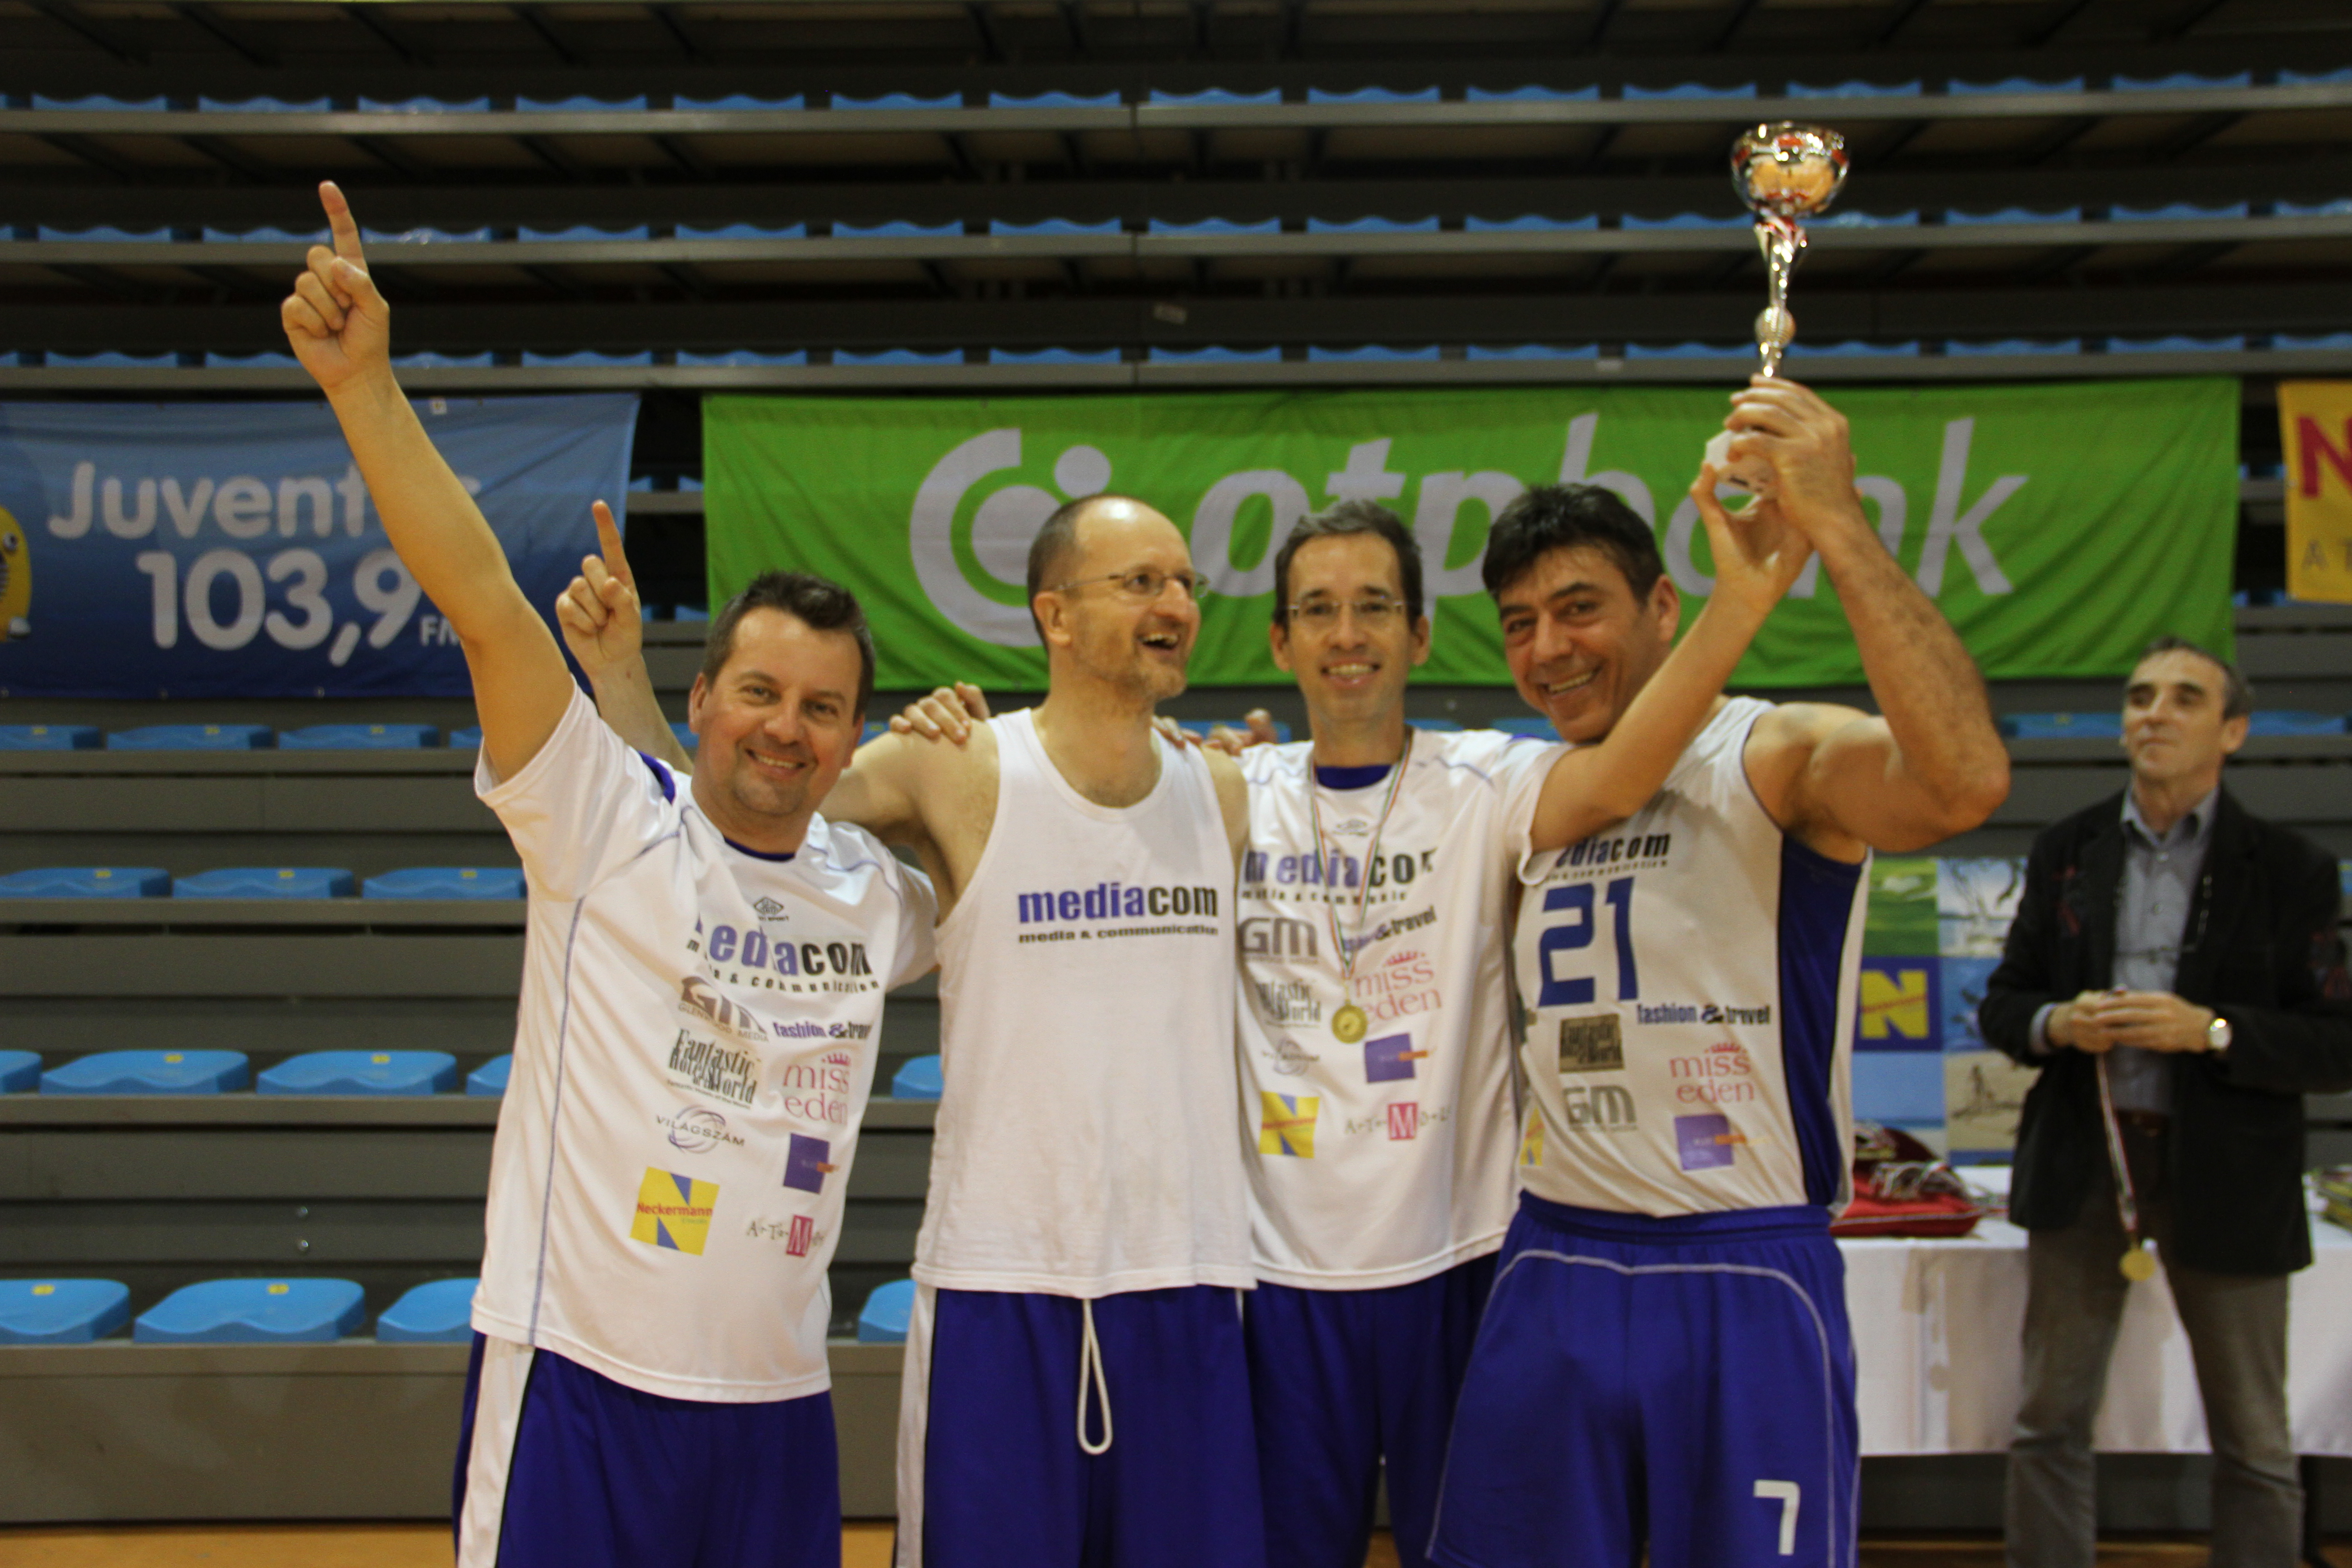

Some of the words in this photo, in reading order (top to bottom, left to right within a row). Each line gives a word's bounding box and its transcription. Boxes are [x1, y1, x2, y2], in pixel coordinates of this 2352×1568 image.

[48, 461, 483, 540] Juvent
[135, 548, 423, 667] 103,9
[1018, 882, 1219, 924] mediacom
[1391, 904, 1437, 935] travel
[1018, 930, 1076, 944] media
[1538, 875, 1639, 1008] 21
[1354, 958, 1435, 998] miss
[1669, 1048, 1751, 1078] miss
[784, 1092, 848, 1126] eden
[1676, 1078, 1754, 1104] eden
[637, 1201, 714, 1217] Neckermann
[1752, 1479, 1801, 1556] 7
